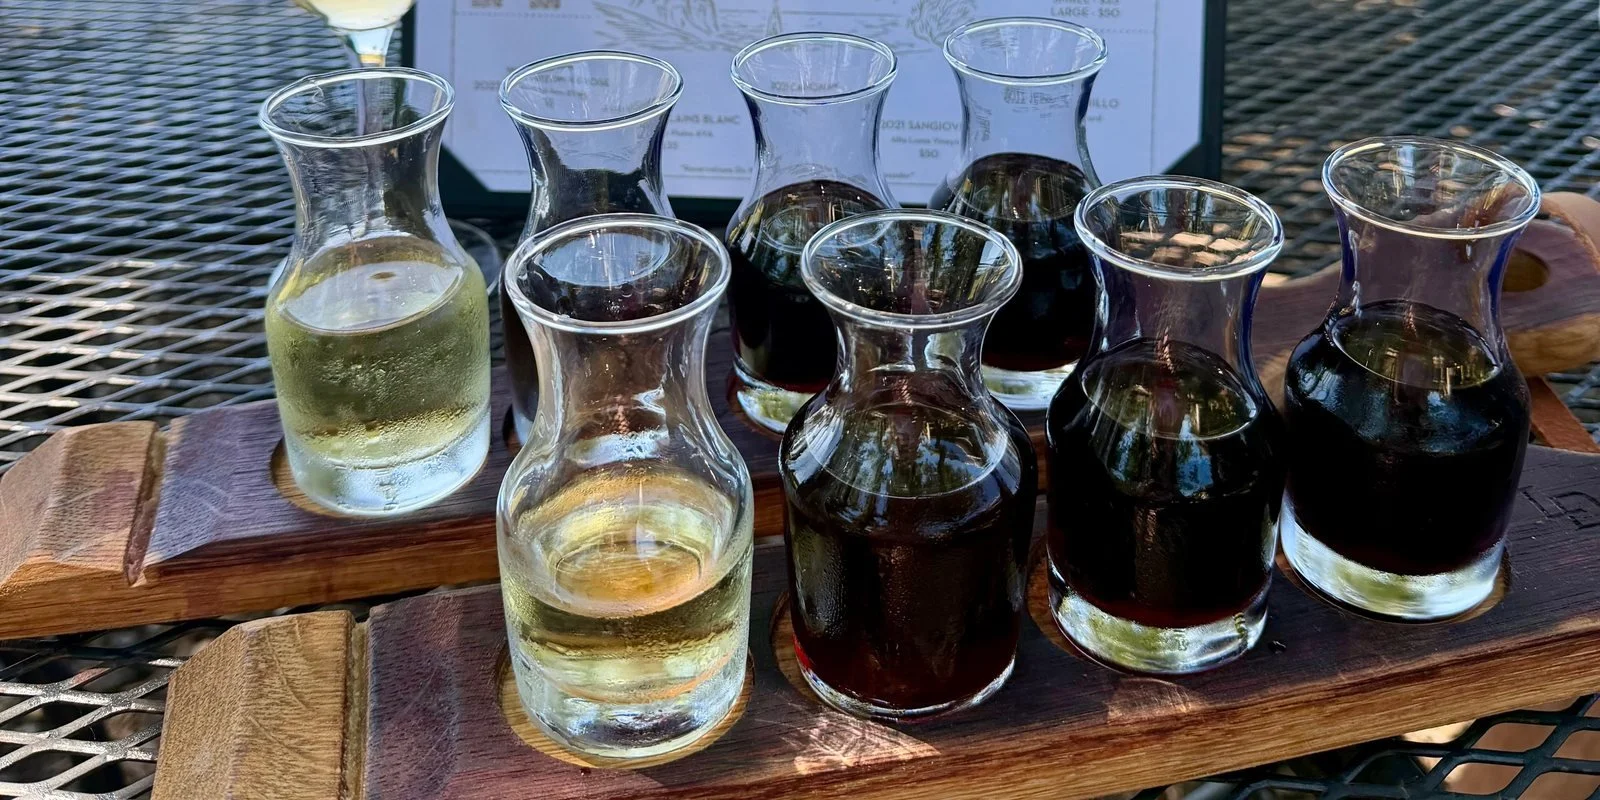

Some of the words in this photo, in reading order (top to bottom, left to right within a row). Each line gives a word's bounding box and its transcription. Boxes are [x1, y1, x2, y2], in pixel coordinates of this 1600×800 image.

[1050, 6, 1089, 17] LARGE
[1098, 7, 1120, 17] $50
[702, 114, 740, 124] BLANC
[880, 120, 904, 130] 2021
[919, 148, 938, 159] $50
